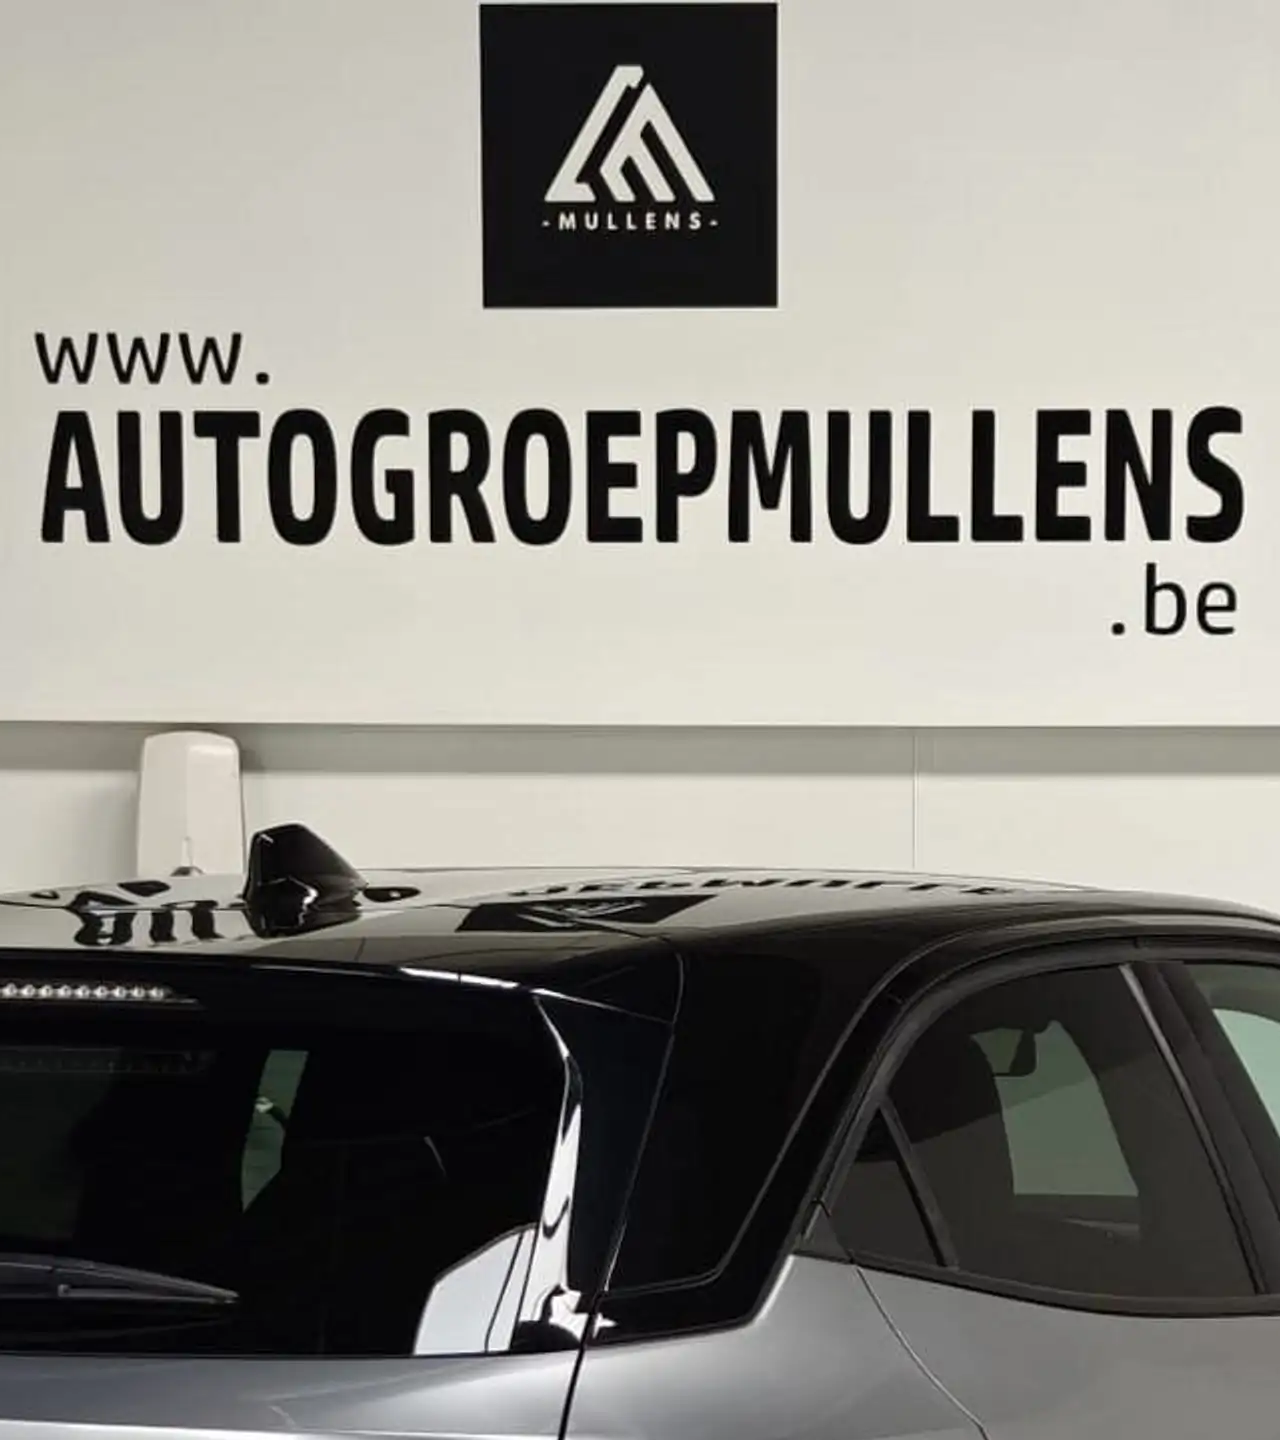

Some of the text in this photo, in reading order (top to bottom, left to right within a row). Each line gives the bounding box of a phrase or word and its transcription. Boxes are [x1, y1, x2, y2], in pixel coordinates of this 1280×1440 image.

[34, 332, 271, 386] www.
[39, 406, 1245, 547] AUTOGROEPMULLENS
[1110, 562, 1238, 637] .be
